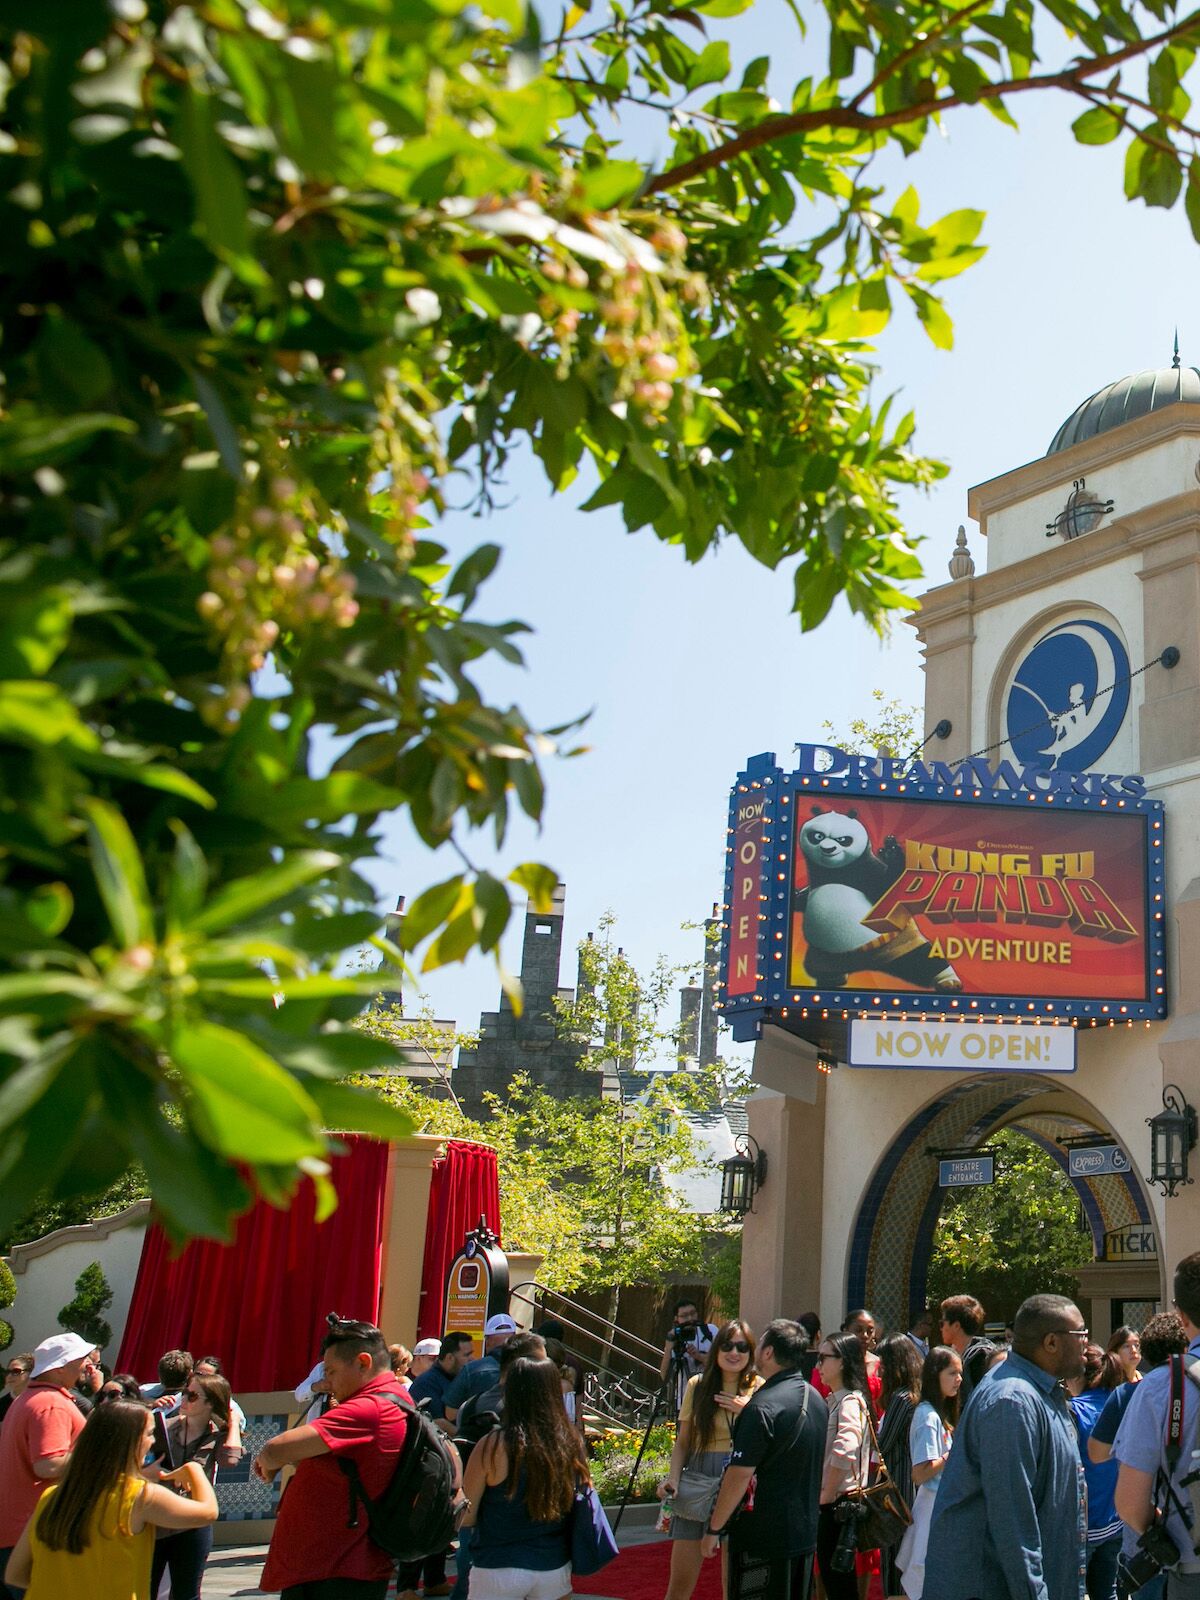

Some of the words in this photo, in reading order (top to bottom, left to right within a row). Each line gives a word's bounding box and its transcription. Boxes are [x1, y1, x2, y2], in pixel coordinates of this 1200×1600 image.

[738, 802, 764, 821] NOW
[905, 839, 1030, 875] KUNG
[1041, 850, 1095, 878] FU
[736, 841, 757, 979] OPEN
[861, 868, 1140, 944] PANDA
[928, 936, 1072, 965] ADVENTURE
[875, 1029, 951, 1059] NOW
[960, 1034, 1052, 1062] OPEN!
[952, 1161, 980, 1171] THEATRE
[1075, 1155, 1102, 1170] EXPRESS
[948, 1171, 983, 1182] ENTRANCE
[1110, 1232, 1156, 1253] TICK
[1172, 1399, 1181, 1421] EOS
